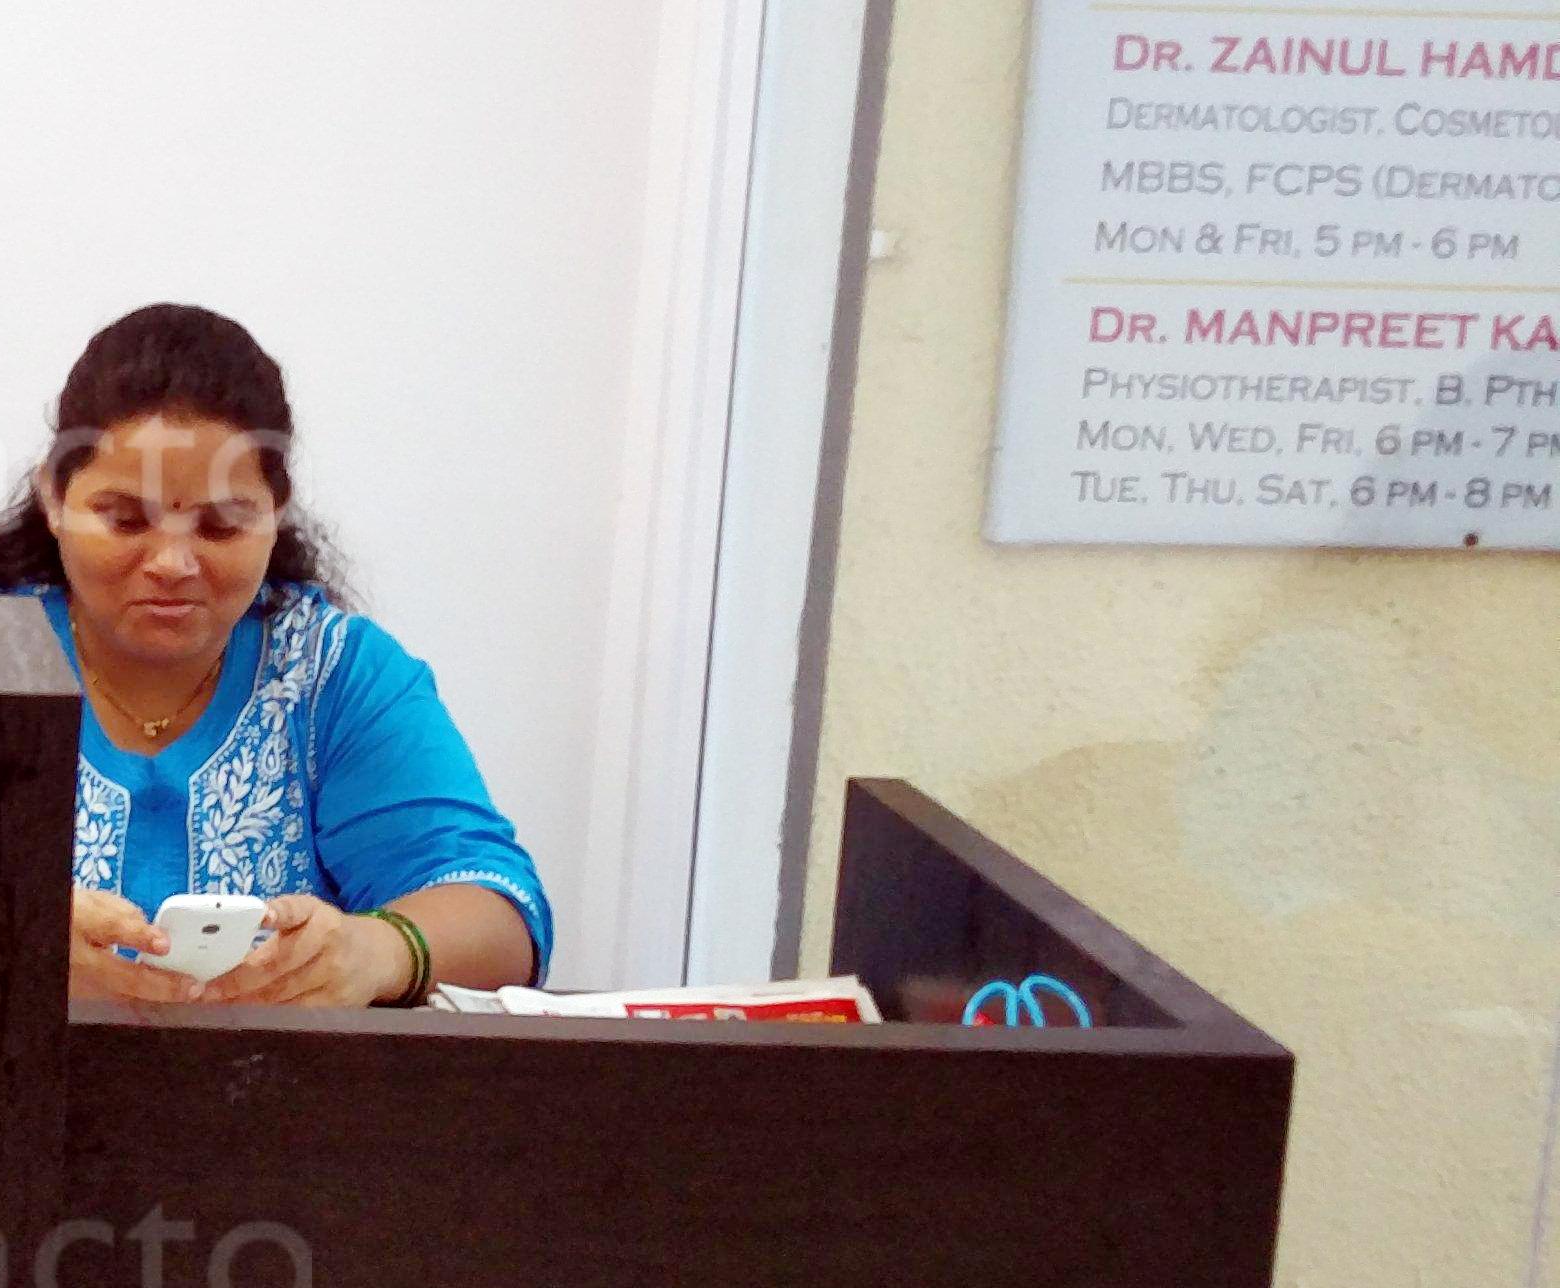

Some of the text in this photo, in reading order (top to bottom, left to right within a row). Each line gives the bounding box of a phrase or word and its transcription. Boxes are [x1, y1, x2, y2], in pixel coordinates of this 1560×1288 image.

[1113, 34, 1193, 72] DR.
[1210, 35, 1407, 77] ZAINUL
[1100, 159, 1560, 202] MBBS, FCPS (DERMATO
[1094, 220, 1186, 254] MON
[1195, 221, 1224, 255] &
[1314, 223, 1341, 258] 5
[1351, 230, 1403, 260] PM
[1431, 226, 1457, 260] 6
[1467, 231, 1520, 260] PM
[1088, 305, 1168, 344] DR.
[1184, 308, 1479, 350] MANPREET
[1375, 424, 1402, 456] 6
[1410, 429, 1465, 457] PM
[1491, 424, 1520, 457] 7
[1350, 475, 1376, 507] 6
[1386, 480, 1439, 508] PM
[1464, 476, 1492, 509] 8
[1500, 483, 1554, 510] PM
